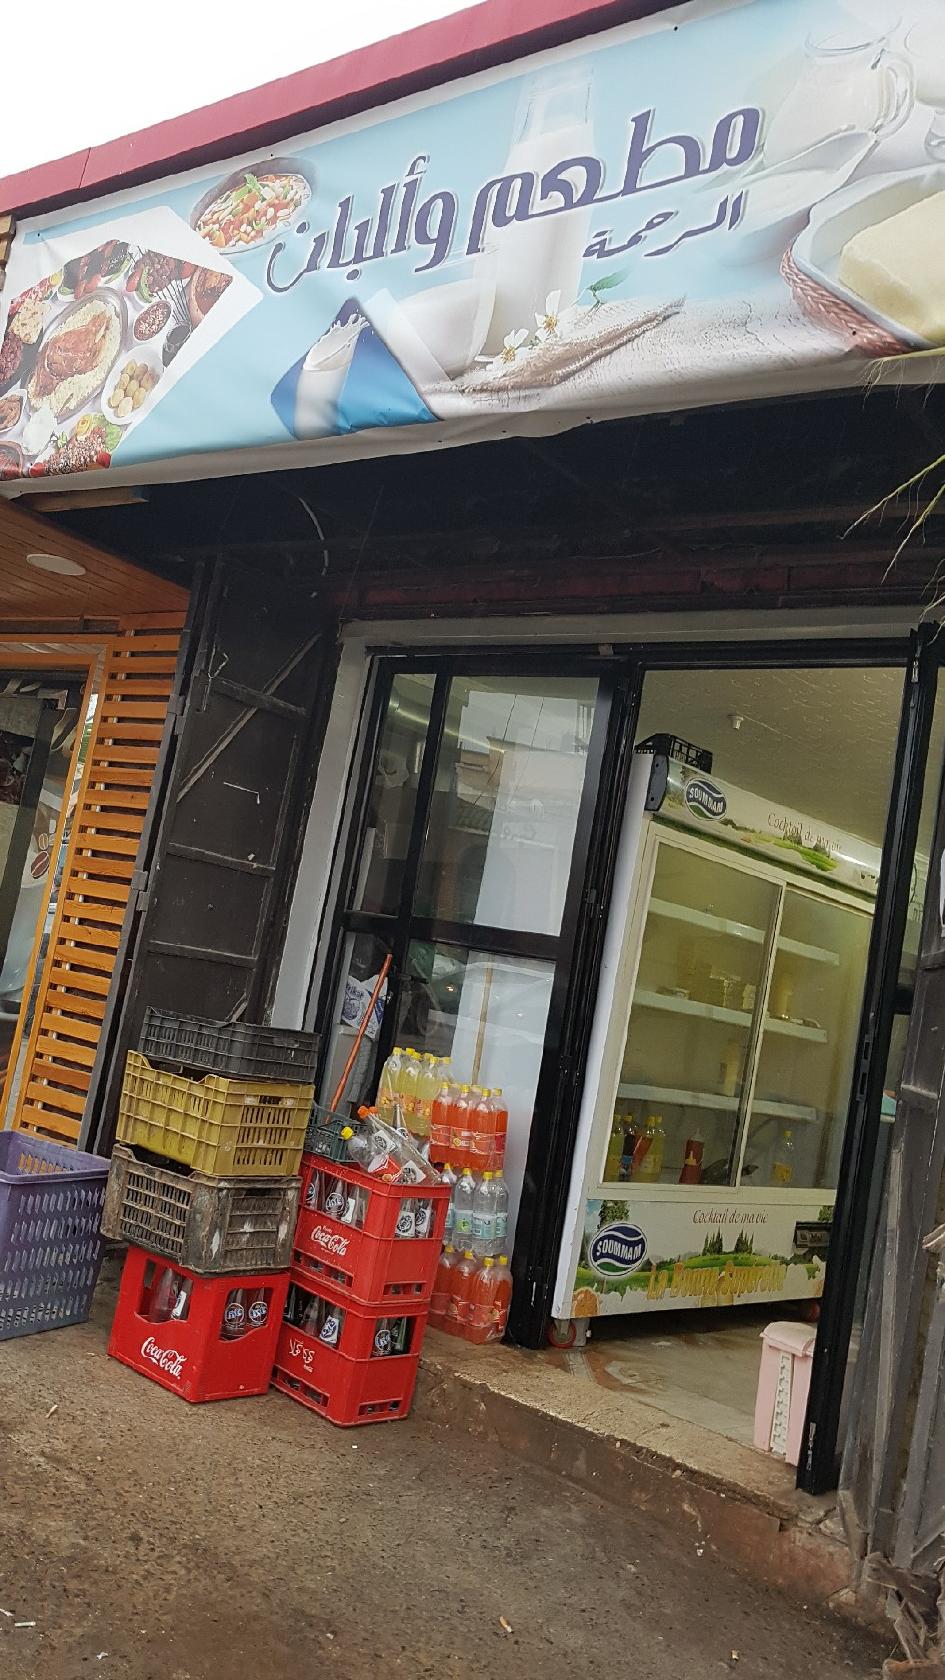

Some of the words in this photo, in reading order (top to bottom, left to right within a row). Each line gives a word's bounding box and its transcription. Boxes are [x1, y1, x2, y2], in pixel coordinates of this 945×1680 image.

[465, 107, 761, 257] مطعم
[266, 155, 458, 293] وألبان
[583, 190, 746, 259] الرحمة
[596, 1240, 642, 1261] SOUMMAM
[693, 1208, 728, 1224] Cocktail
[728, 1209, 740, 1224] de
[740, 1212, 757, 1224] ma
